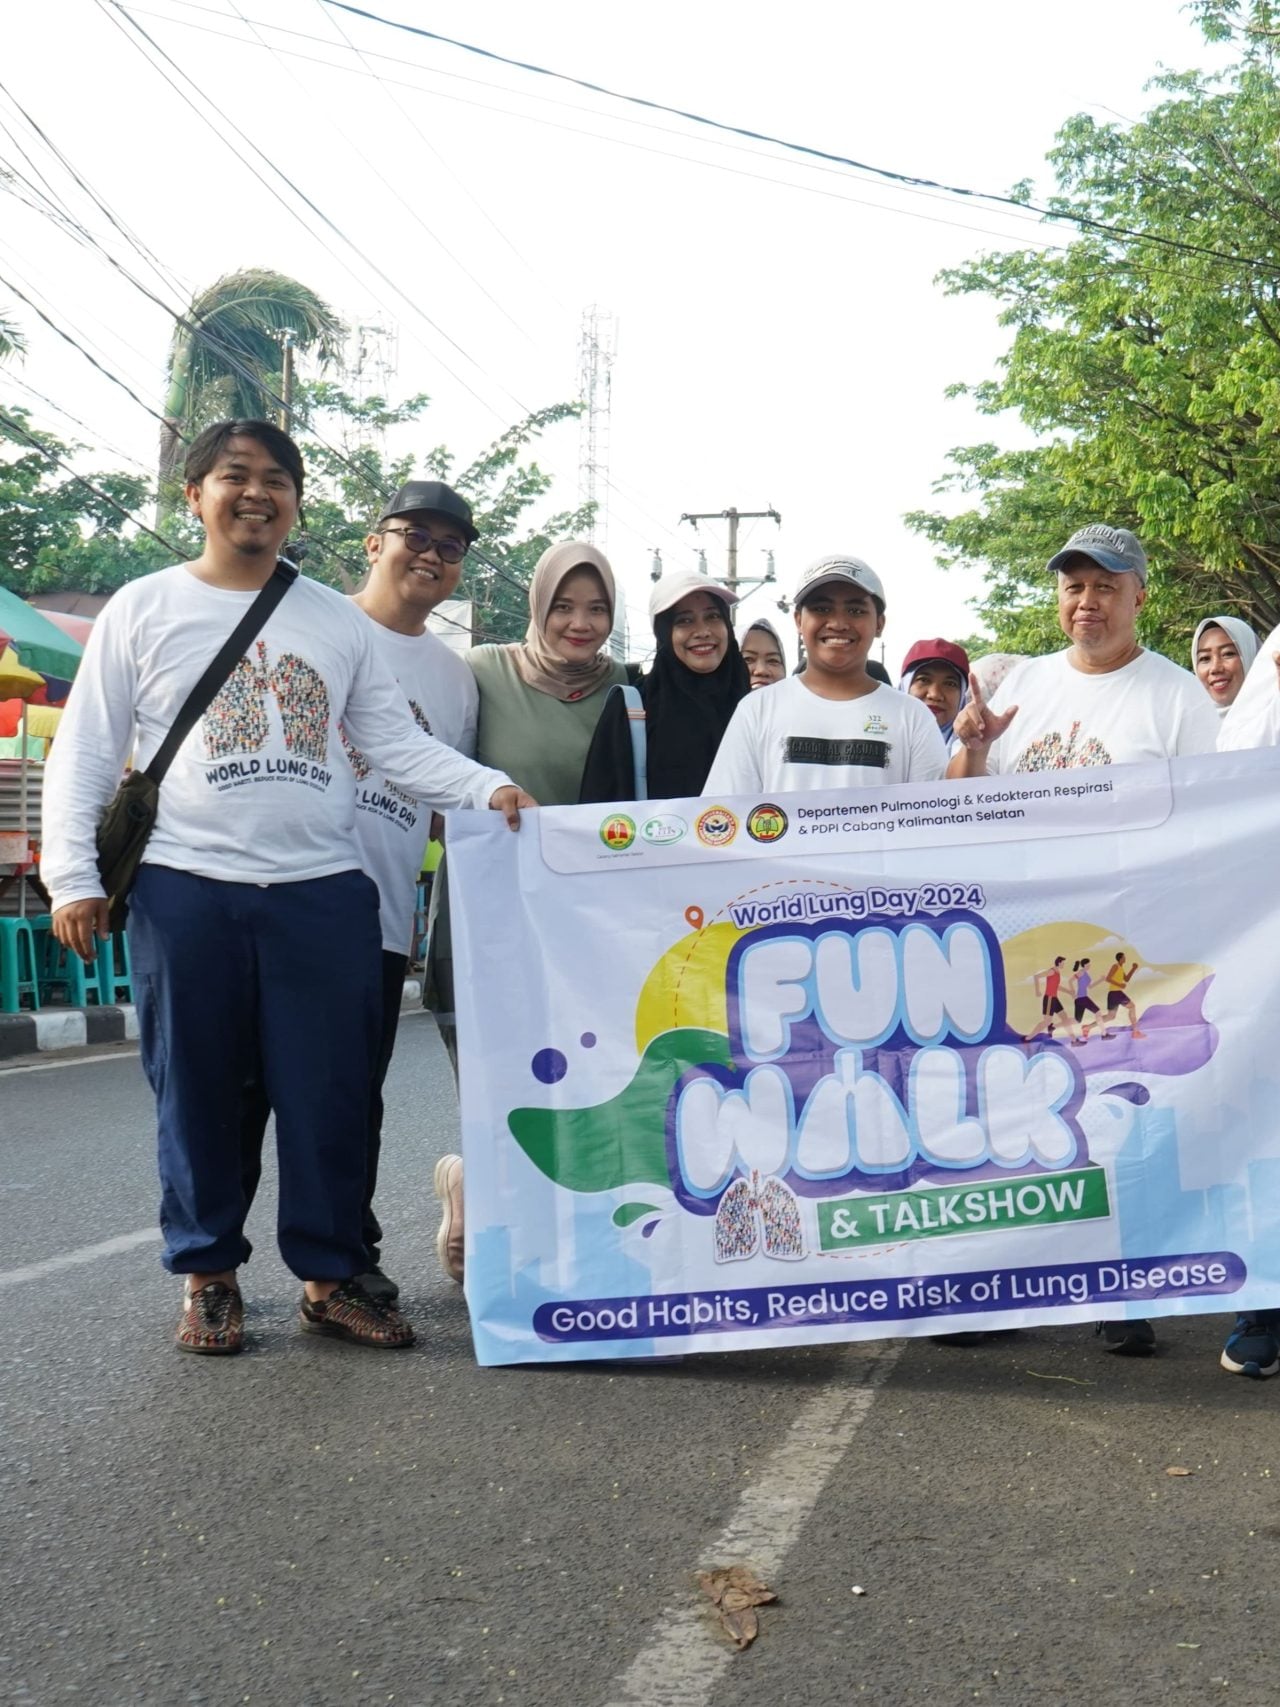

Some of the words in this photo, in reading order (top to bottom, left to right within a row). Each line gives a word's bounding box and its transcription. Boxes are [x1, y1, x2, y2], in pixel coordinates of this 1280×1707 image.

[205, 759, 261, 785] WORLD
[266, 758, 308, 777] LUNG
[311, 766, 333, 787] DAY
[362, 789, 398, 814] LUNG
[398, 806, 417, 828] DAY
[797, 803, 878, 820] Departemen
[881, 795, 960, 812] Pulmonologi
[964, 795, 974, 806] &
[976, 788, 1051, 804] Kedokteran
[1054, 780, 1113, 798] Respirasi
[798, 825, 808, 835] &
[811, 823, 839, 834] PDPI
[842, 820, 895, 833] Cabang
[898, 812, 973, 828] Kalimantan
[975, 808, 1025, 822] Selatan
[733, 898, 802, 926] World
[808, 893, 865, 915] Lung
[872, 890, 918, 913] Day
[923, 887, 982, 906] 2024
[740, 924, 993, 1060] FUN
[678, 1047, 1076, 1196] WALK
[830, 1207, 859, 1239] &
[869, 1179, 1086, 1233] TALKSHOW
[551, 1302, 638, 1333] Good
[649, 1294, 759, 1327] Habits,
[768, 1288, 889, 1318] Reduce
[898, 1279, 962, 1309] Risk
[971, 1273, 1002, 1301] of
[1011, 1272, 1088, 1302] Lung
[1099, 1263, 1226, 1293] Disease
